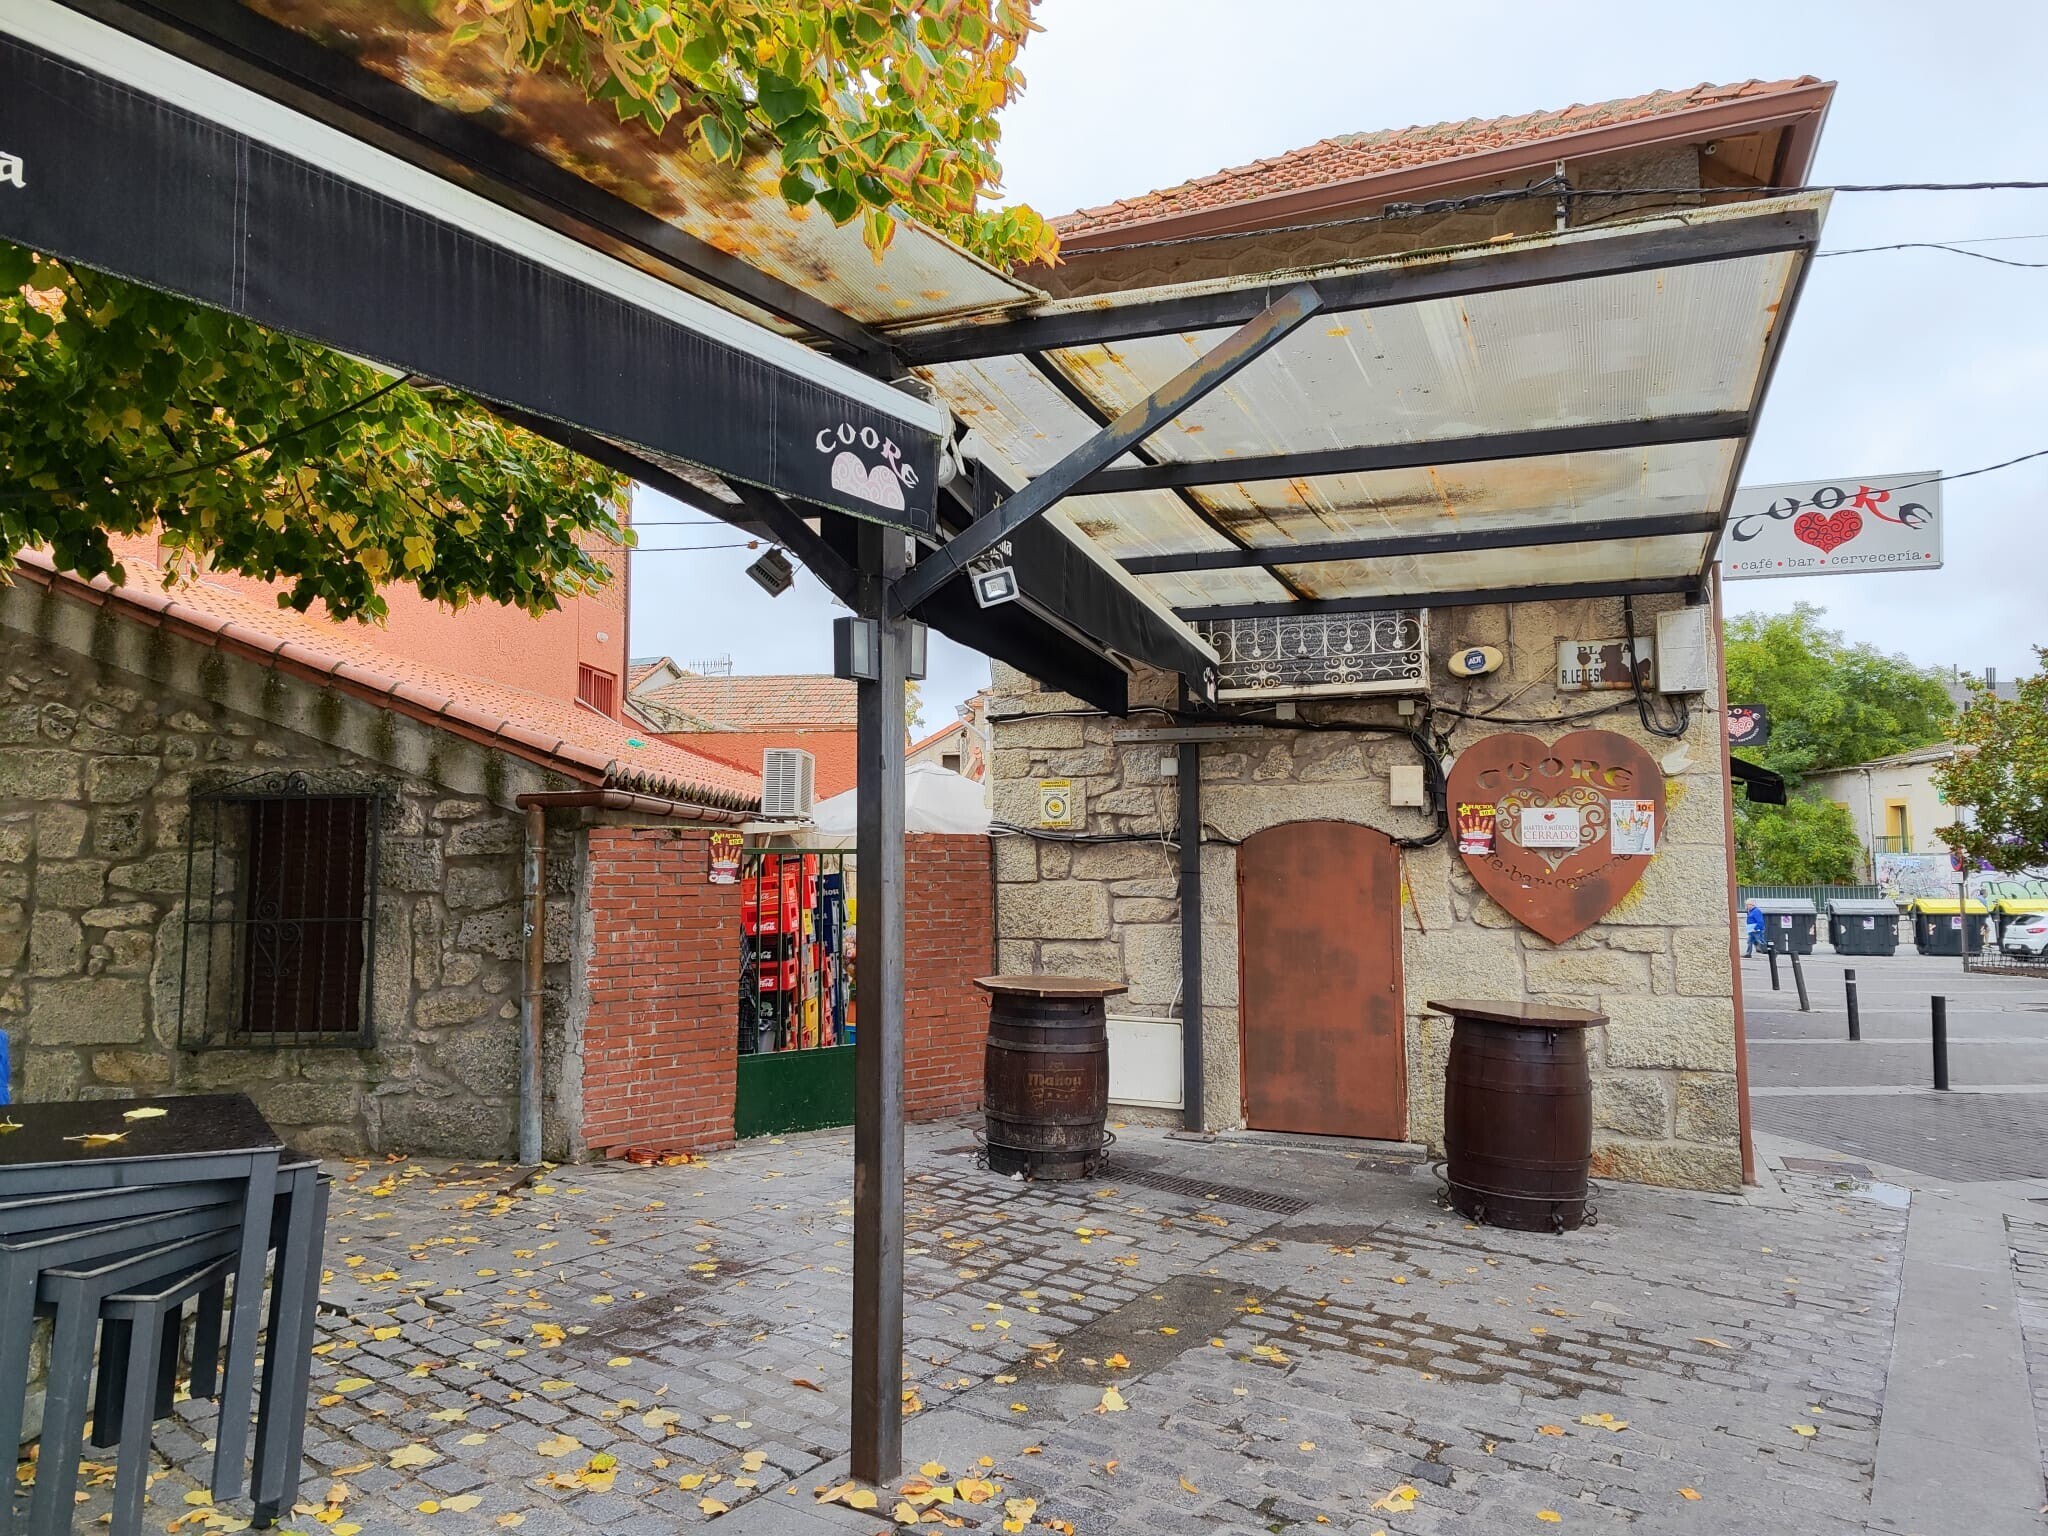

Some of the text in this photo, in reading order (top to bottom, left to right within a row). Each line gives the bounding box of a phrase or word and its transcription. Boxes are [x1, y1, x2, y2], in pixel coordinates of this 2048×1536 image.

[815, 422, 920, 489] CUORE
[1731, 484, 1934, 542] CUORE
[1740, 549, 1922, 572] café bar cervecería
[1467, 655, 1483, 666] ADT
[1476, 757, 1634, 793] CUORE
[1523, 830, 1578, 840] CERRADO
[1510, 864, 1545, 889] bar
